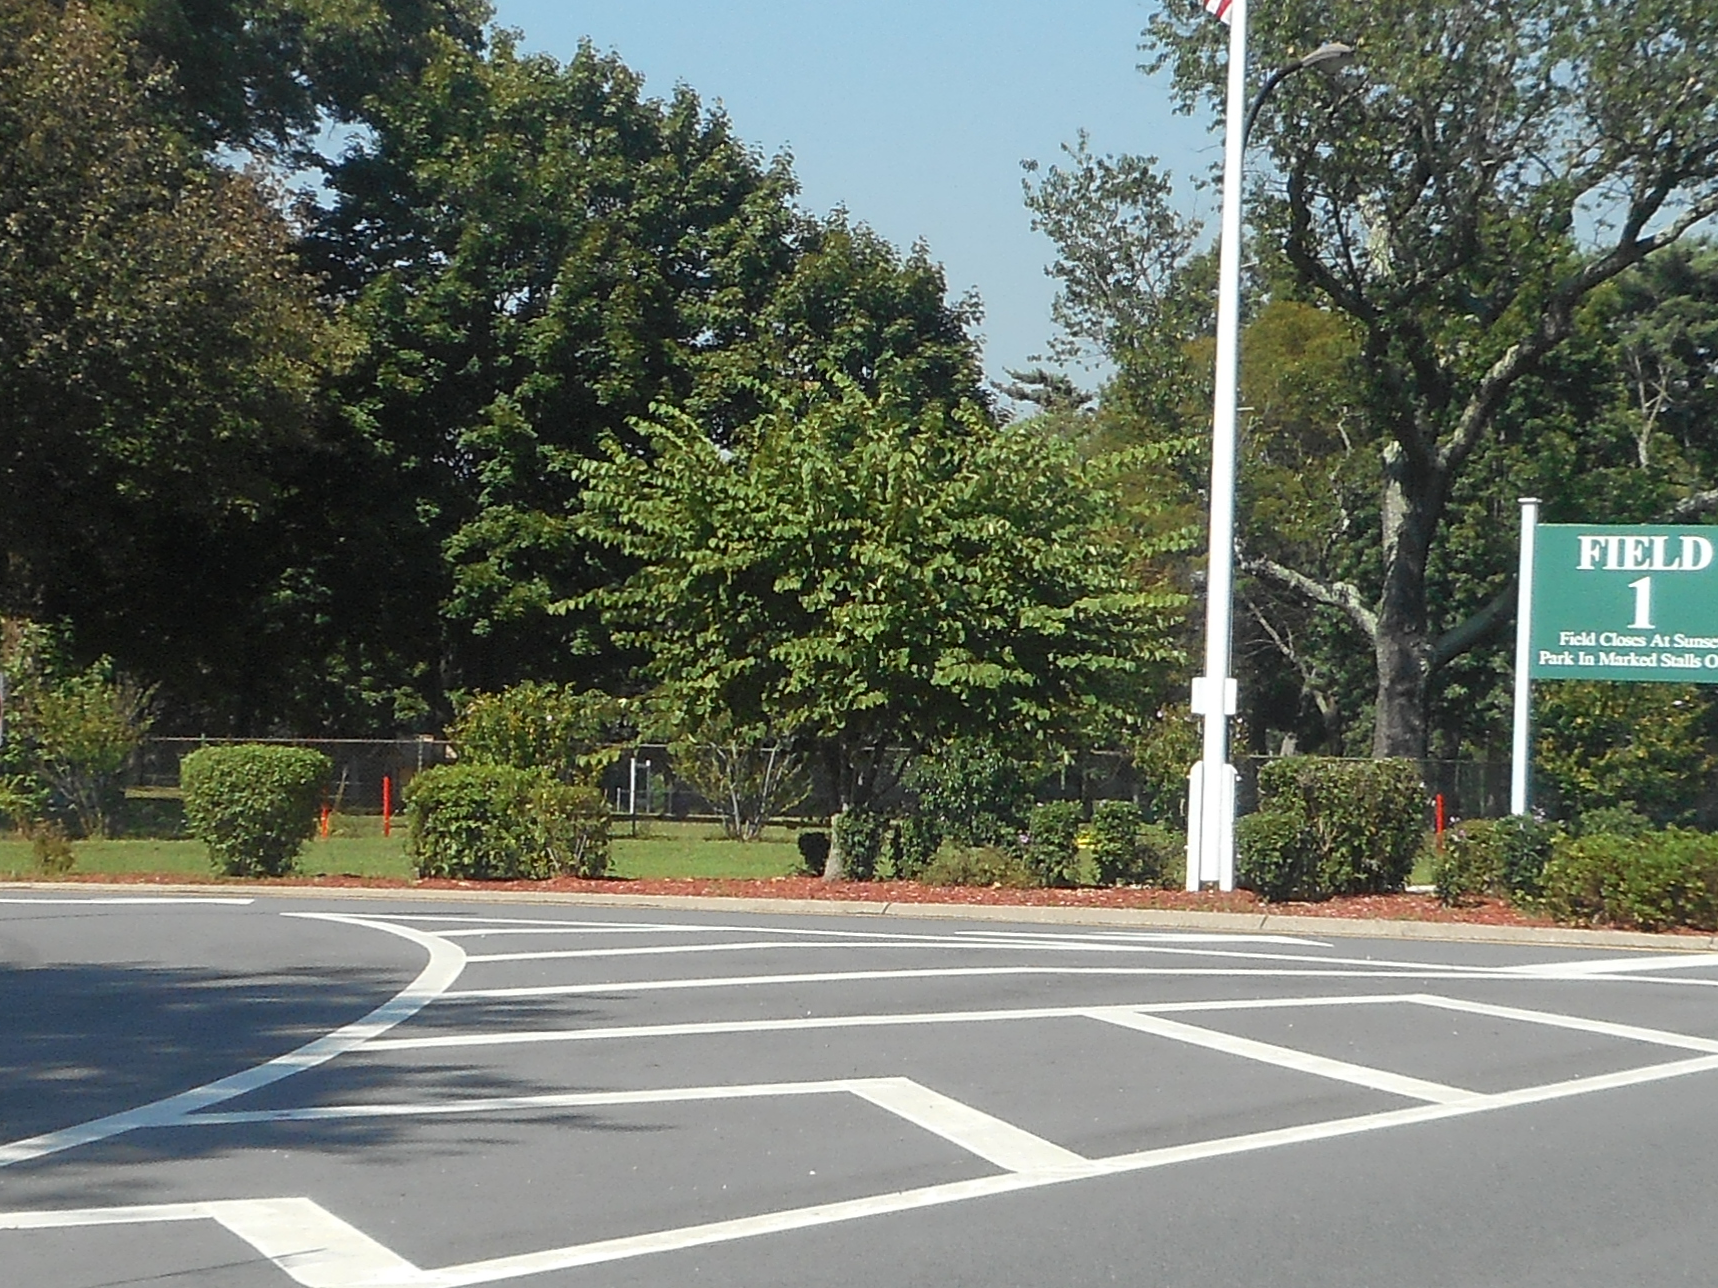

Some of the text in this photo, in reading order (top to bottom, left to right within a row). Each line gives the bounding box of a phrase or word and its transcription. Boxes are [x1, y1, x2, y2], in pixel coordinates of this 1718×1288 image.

[1576, 535, 1713, 571] FIELD
[1627, 576, 1656, 629] 1
[1559, 631, 1596, 646] Field
[1599, 632, 1647, 647] Closes
[1649, 634, 1671, 647] At
[1539, 650, 1575, 665] Park
[1578, 651, 1595, 666] In
[1598, 651, 1658, 667] Marked
[1660, 653, 1703, 668] Stalls
